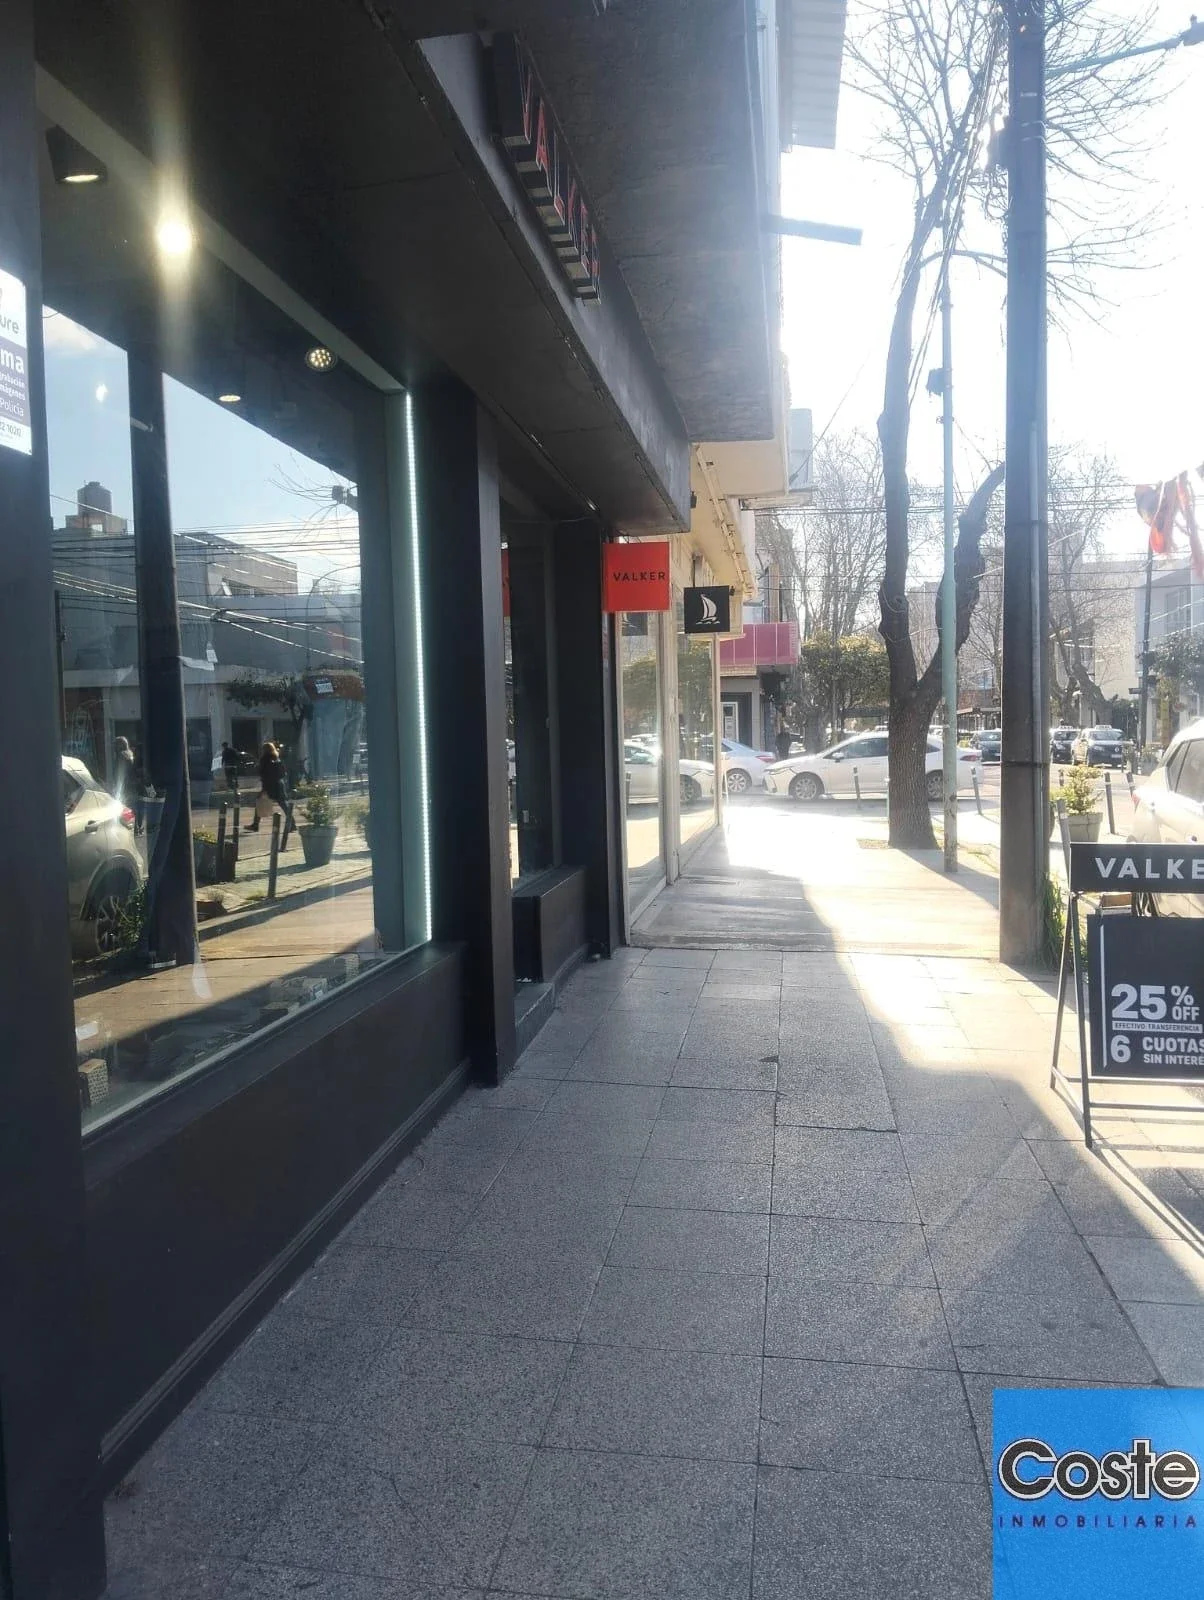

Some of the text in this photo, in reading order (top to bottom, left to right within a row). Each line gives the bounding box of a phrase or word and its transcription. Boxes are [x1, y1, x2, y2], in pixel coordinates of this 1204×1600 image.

[613, 571, 666, 582] VALKER
[1095, 857, 1204, 880] VALKE
[1172, 1006, 1200, 1021] OFF
[1114, 1022, 1200, 1032] EFECTIVO TRANSFERENCIA
[1110, 1034, 1131, 1063] 6
[1143, 1053, 1162, 1064] SIN
